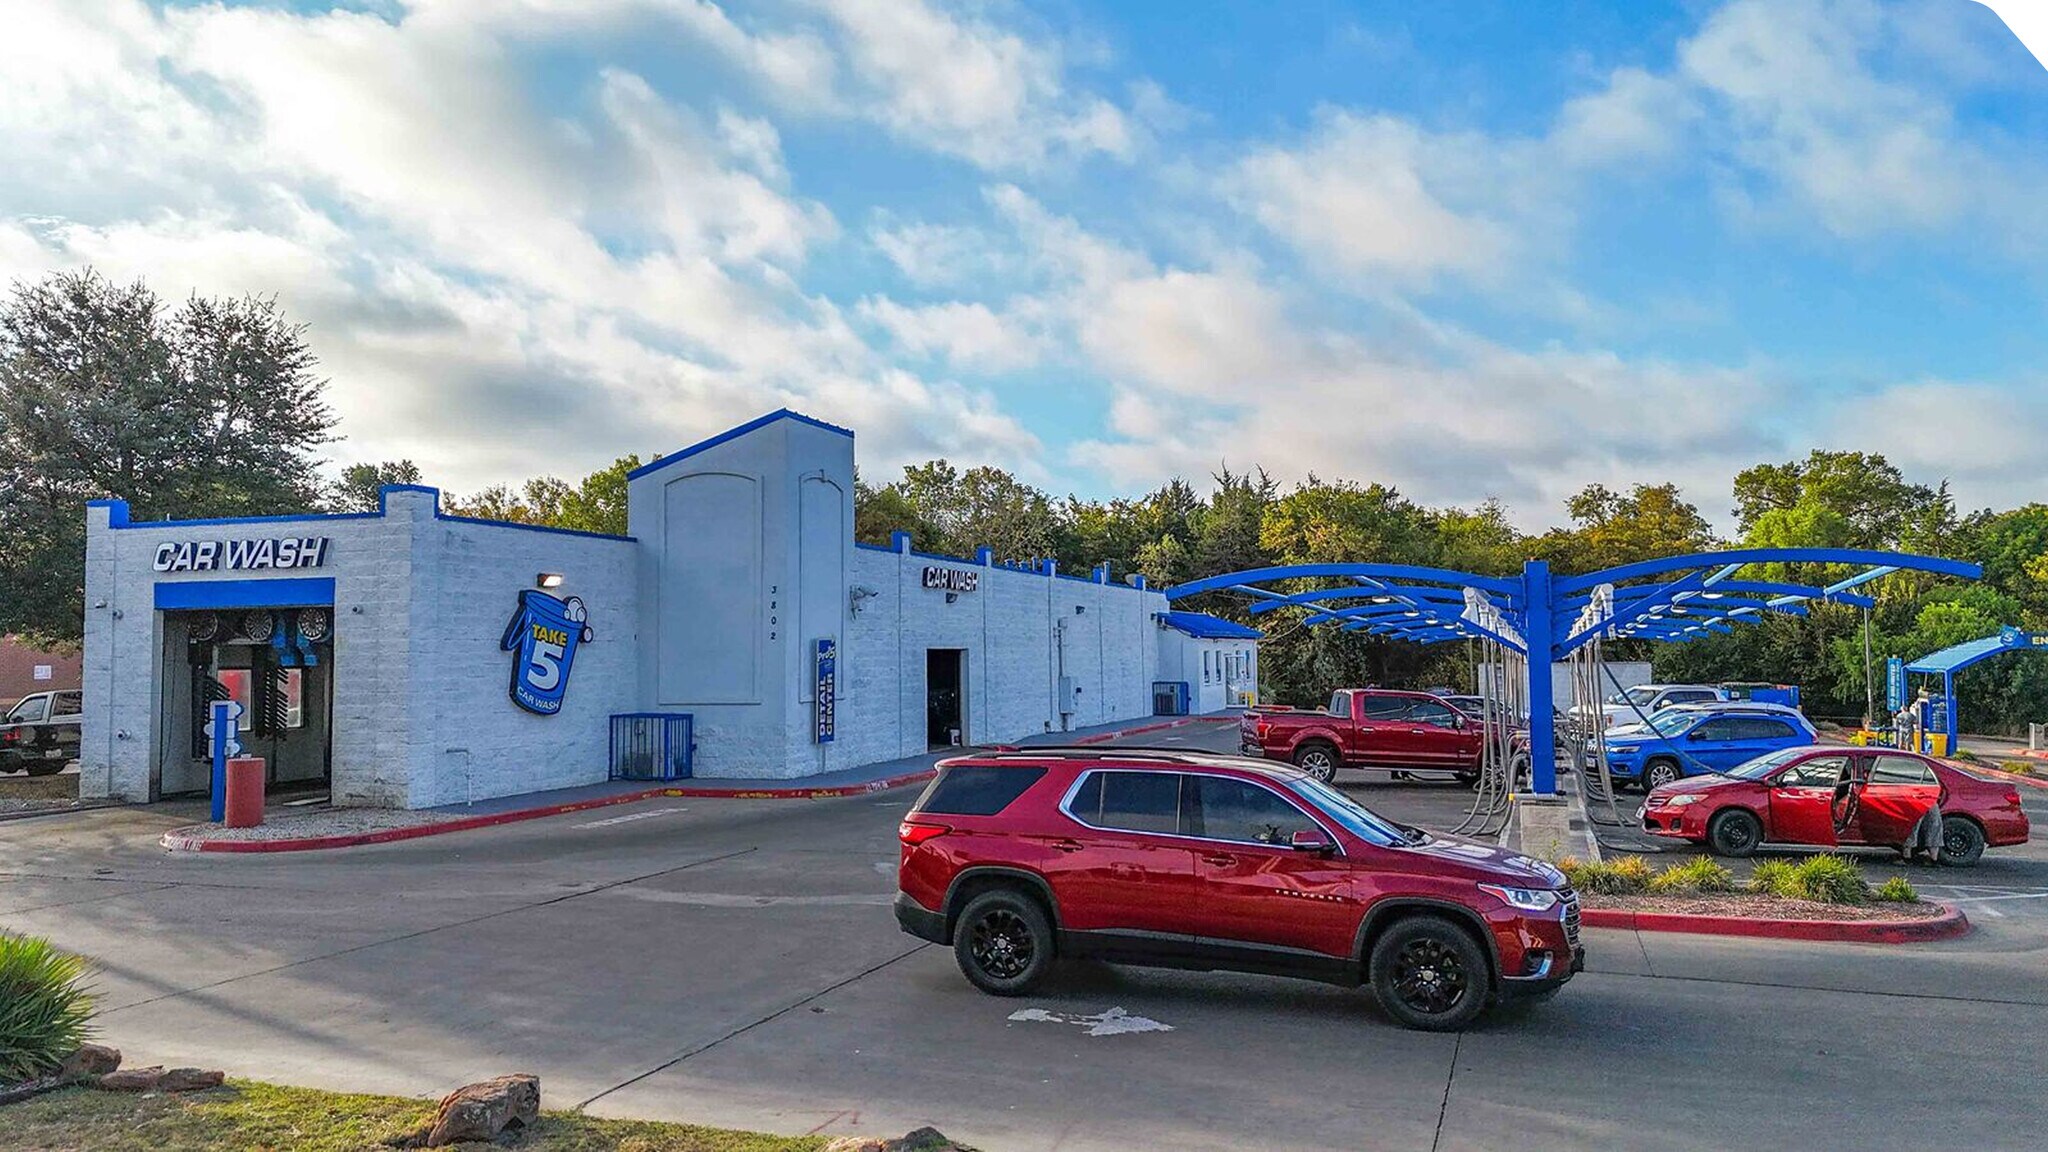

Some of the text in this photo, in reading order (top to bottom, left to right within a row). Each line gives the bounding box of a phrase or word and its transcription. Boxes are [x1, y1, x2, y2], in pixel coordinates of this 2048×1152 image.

[153, 537, 329, 573] CAR WASH
[926, 566, 979, 592] CAR WASH
[533, 624, 568, 647] TAKE
[527, 641, 564, 691] 5
[517, 686, 560, 711] CAR WASH
